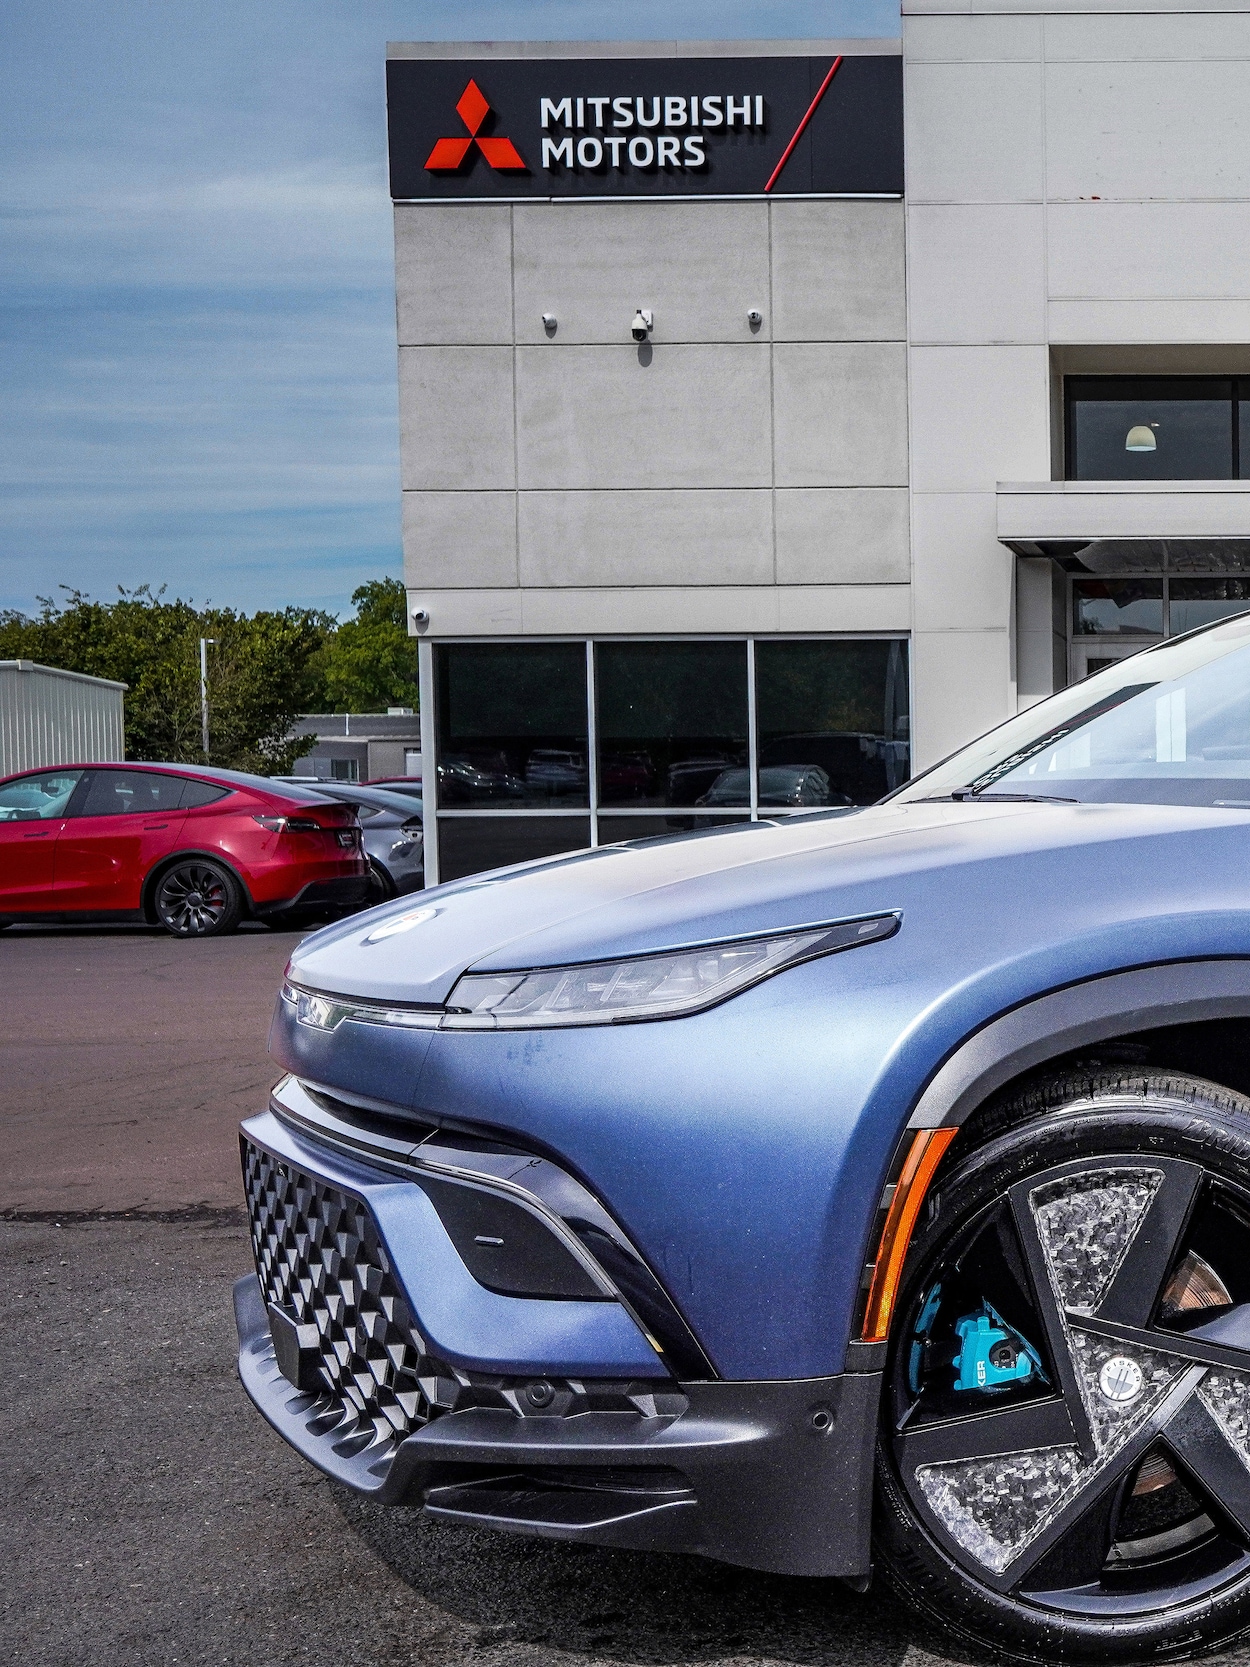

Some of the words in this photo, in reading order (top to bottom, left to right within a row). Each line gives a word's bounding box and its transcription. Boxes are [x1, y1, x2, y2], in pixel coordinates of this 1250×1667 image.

[540, 95, 764, 129] MITSUBISHI
[541, 135, 706, 169] MOTORS
[1105, 1360, 1142, 1383] FISKER
